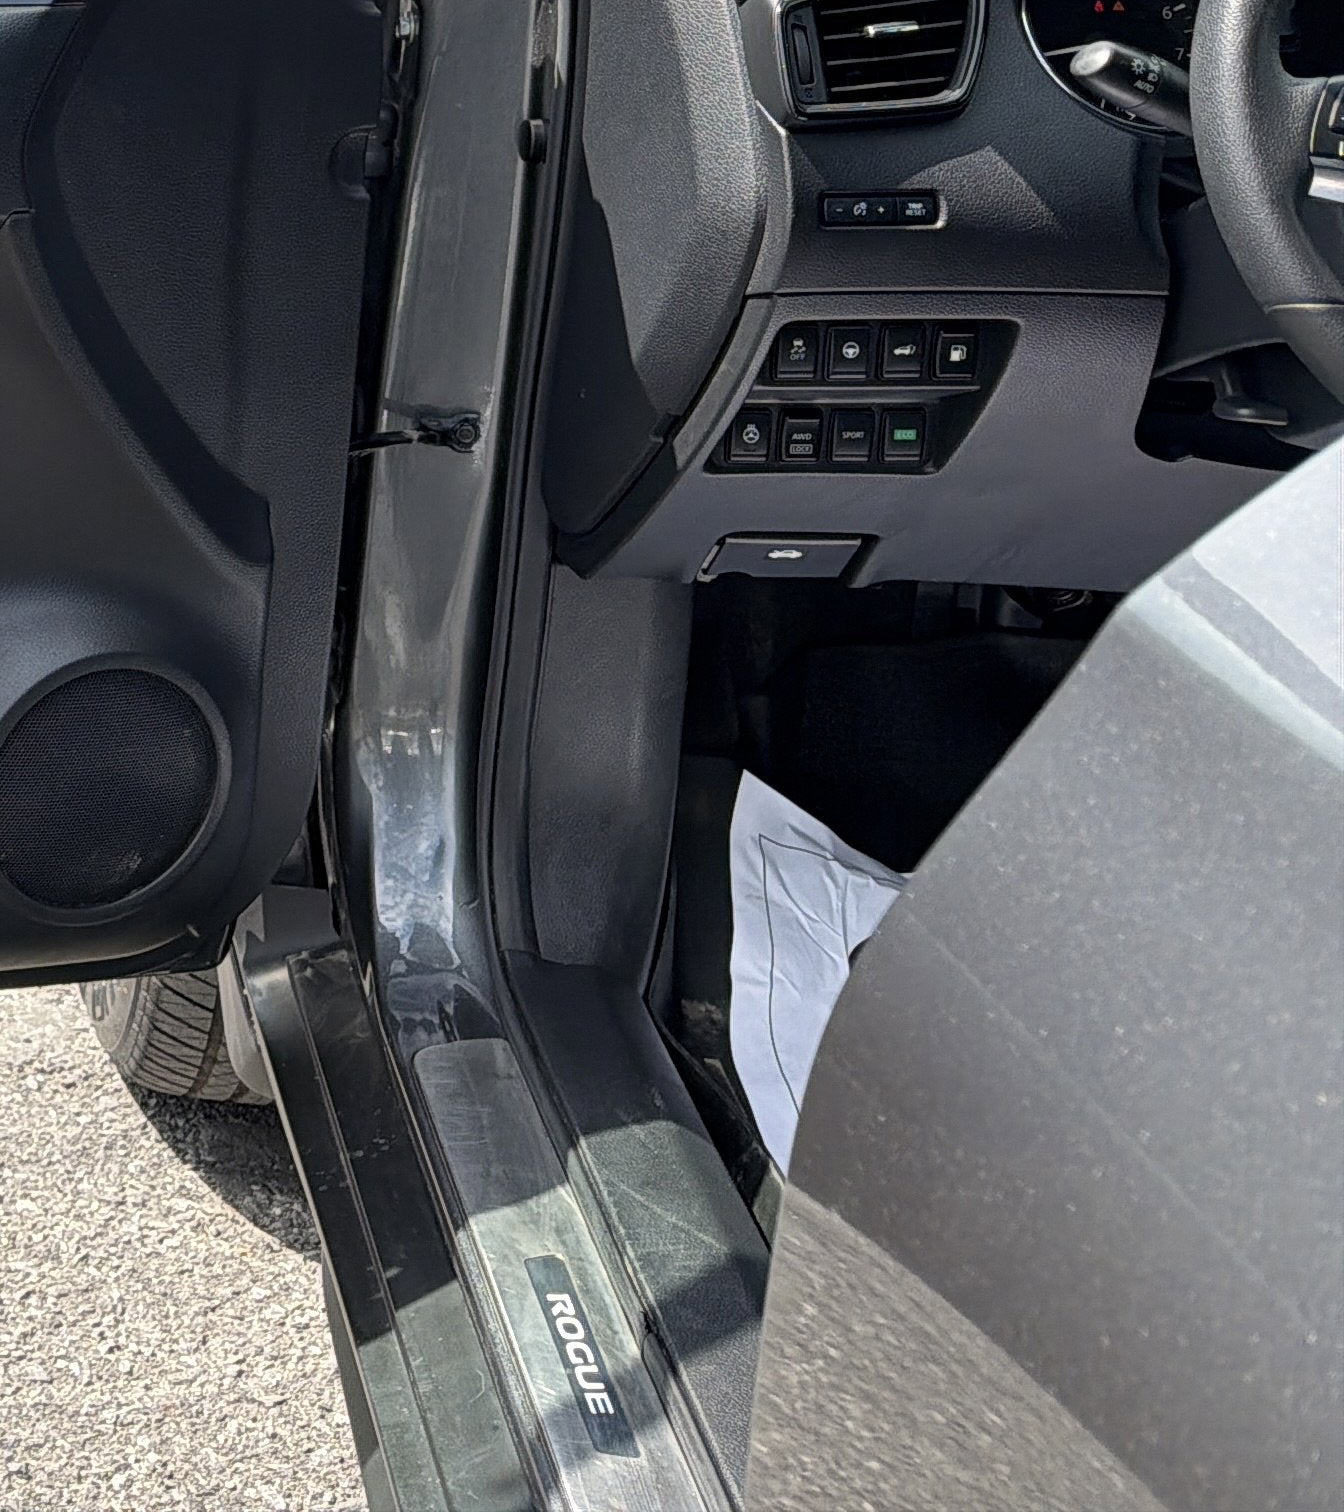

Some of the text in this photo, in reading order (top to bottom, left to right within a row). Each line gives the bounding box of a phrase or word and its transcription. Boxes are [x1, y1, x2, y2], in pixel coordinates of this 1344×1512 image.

[1162, 7, 1172, 20] 6
[1175, 48, 1184, 61] 7
[1133, 80, 1155, 94] AUTO
[905, 208, 927, 216] RESET
[789, 353, 805, 361] OFF
[791, 432, 812, 441] AWD
[842, 431, 865, 439] SPORT
[896, 430, 914, 438] ECO
[792, 445, 811, 453] LOCK
[545, 1292, 615, 1415] ROGUE
